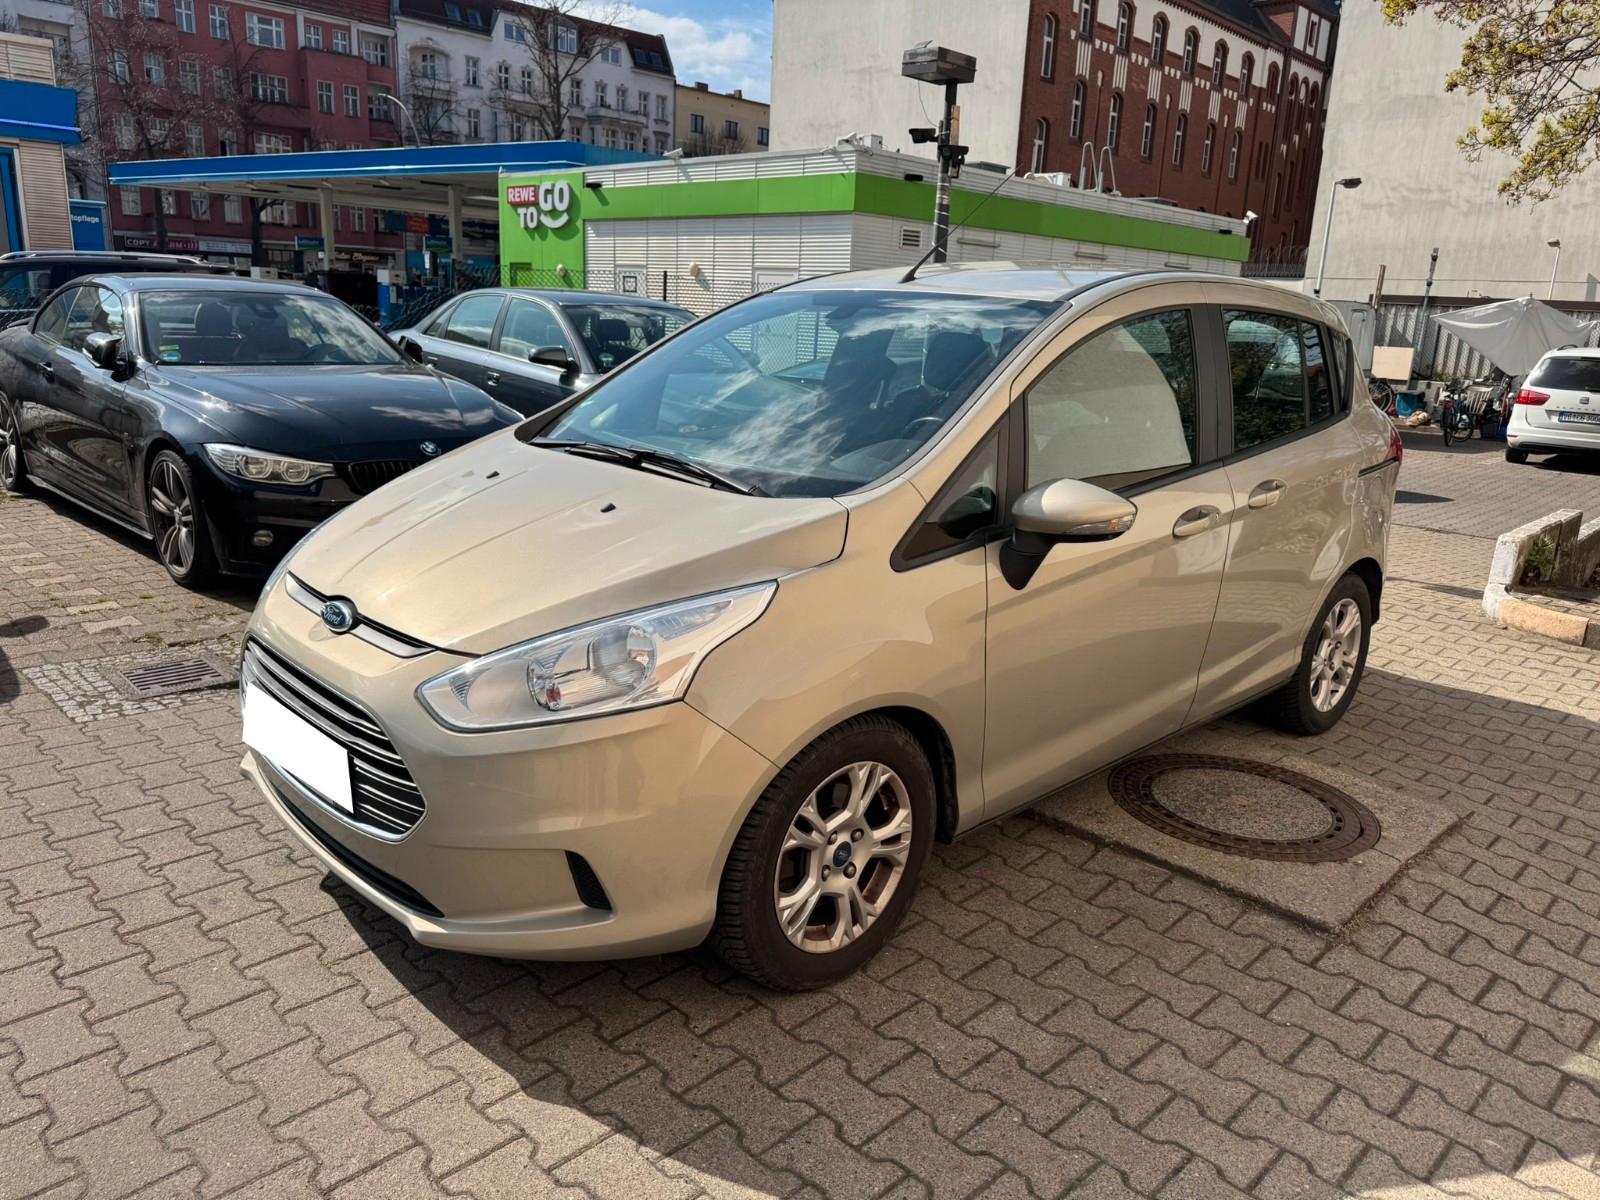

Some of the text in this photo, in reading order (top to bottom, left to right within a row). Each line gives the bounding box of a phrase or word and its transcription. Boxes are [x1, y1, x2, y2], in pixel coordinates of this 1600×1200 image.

[508, 187, 535, 202] REWE
[517, 180, 570, 229] TO GO
[127, 239, 150, 247] COPY
